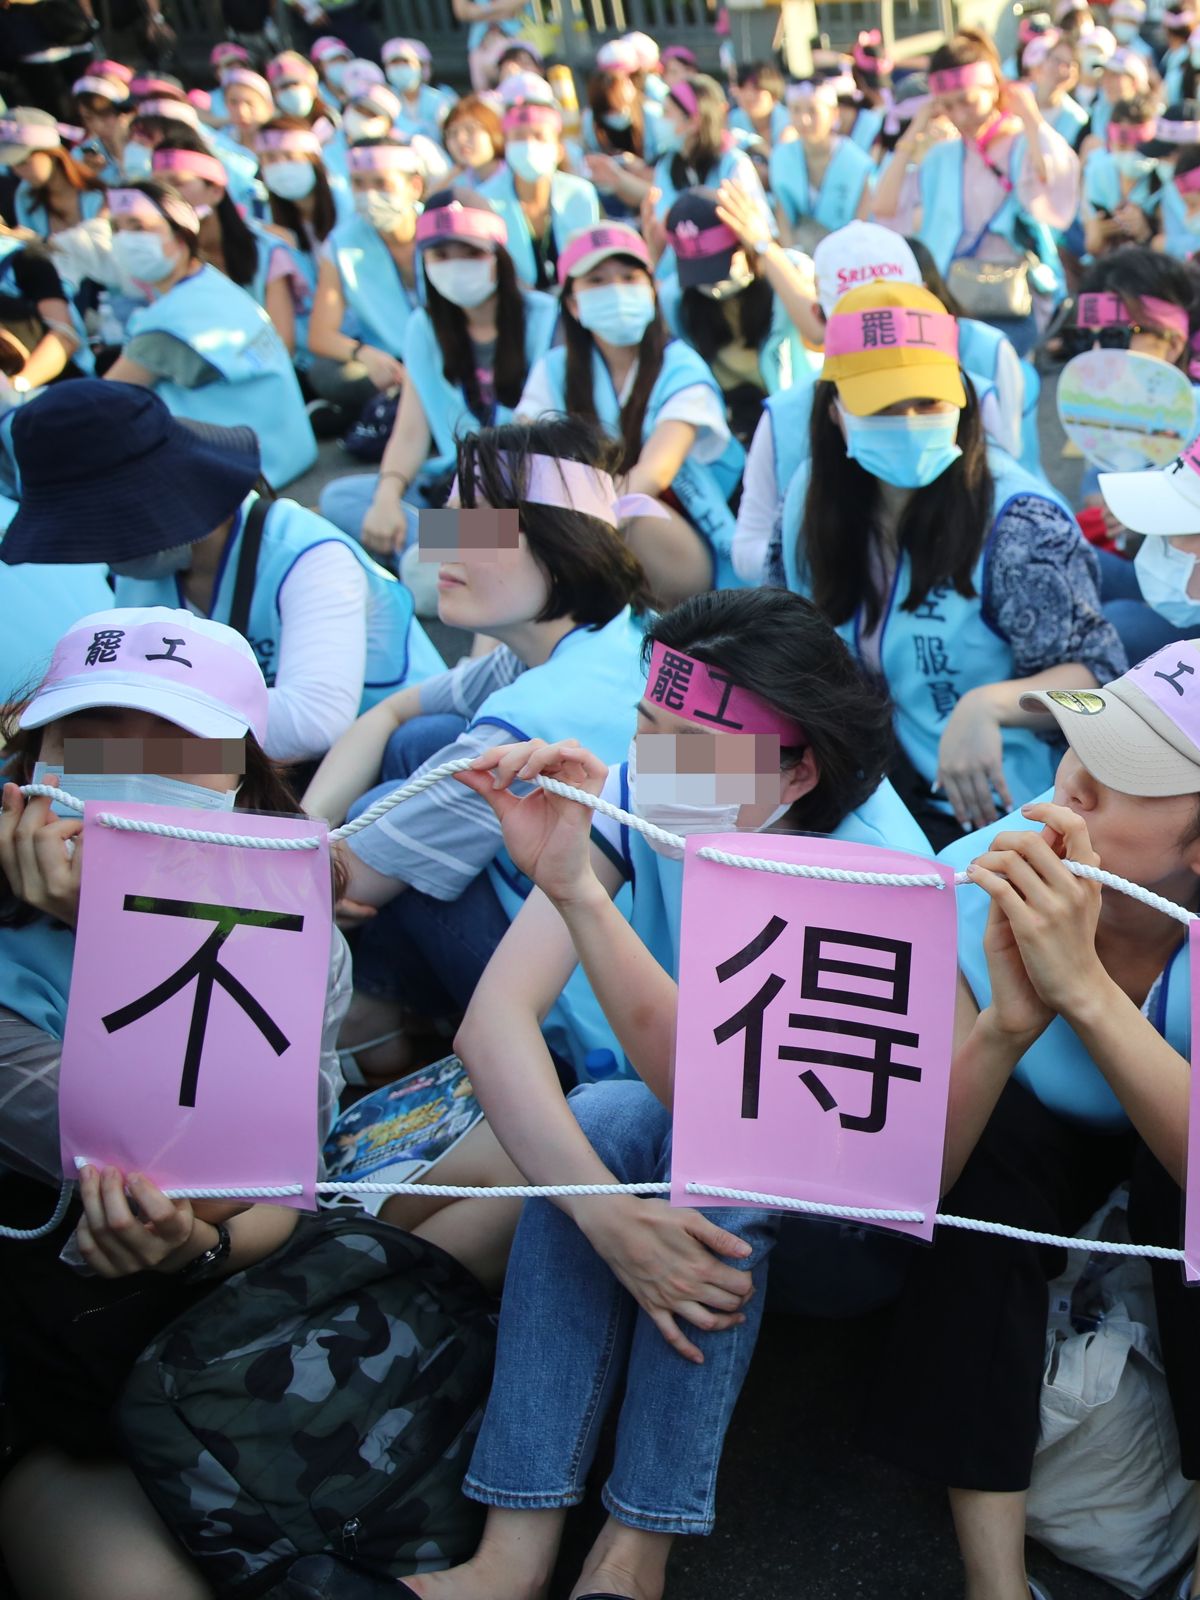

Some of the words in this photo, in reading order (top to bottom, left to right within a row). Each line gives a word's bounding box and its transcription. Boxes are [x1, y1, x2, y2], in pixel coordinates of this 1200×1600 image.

[862, 310, 937, 348] 罷工
[85, 629, 193, 668] 罷工
[650, 651, 743, 730] 罷工
[101, 894, 304, 1108] 不
[713, 914, 922, 1133] 得
